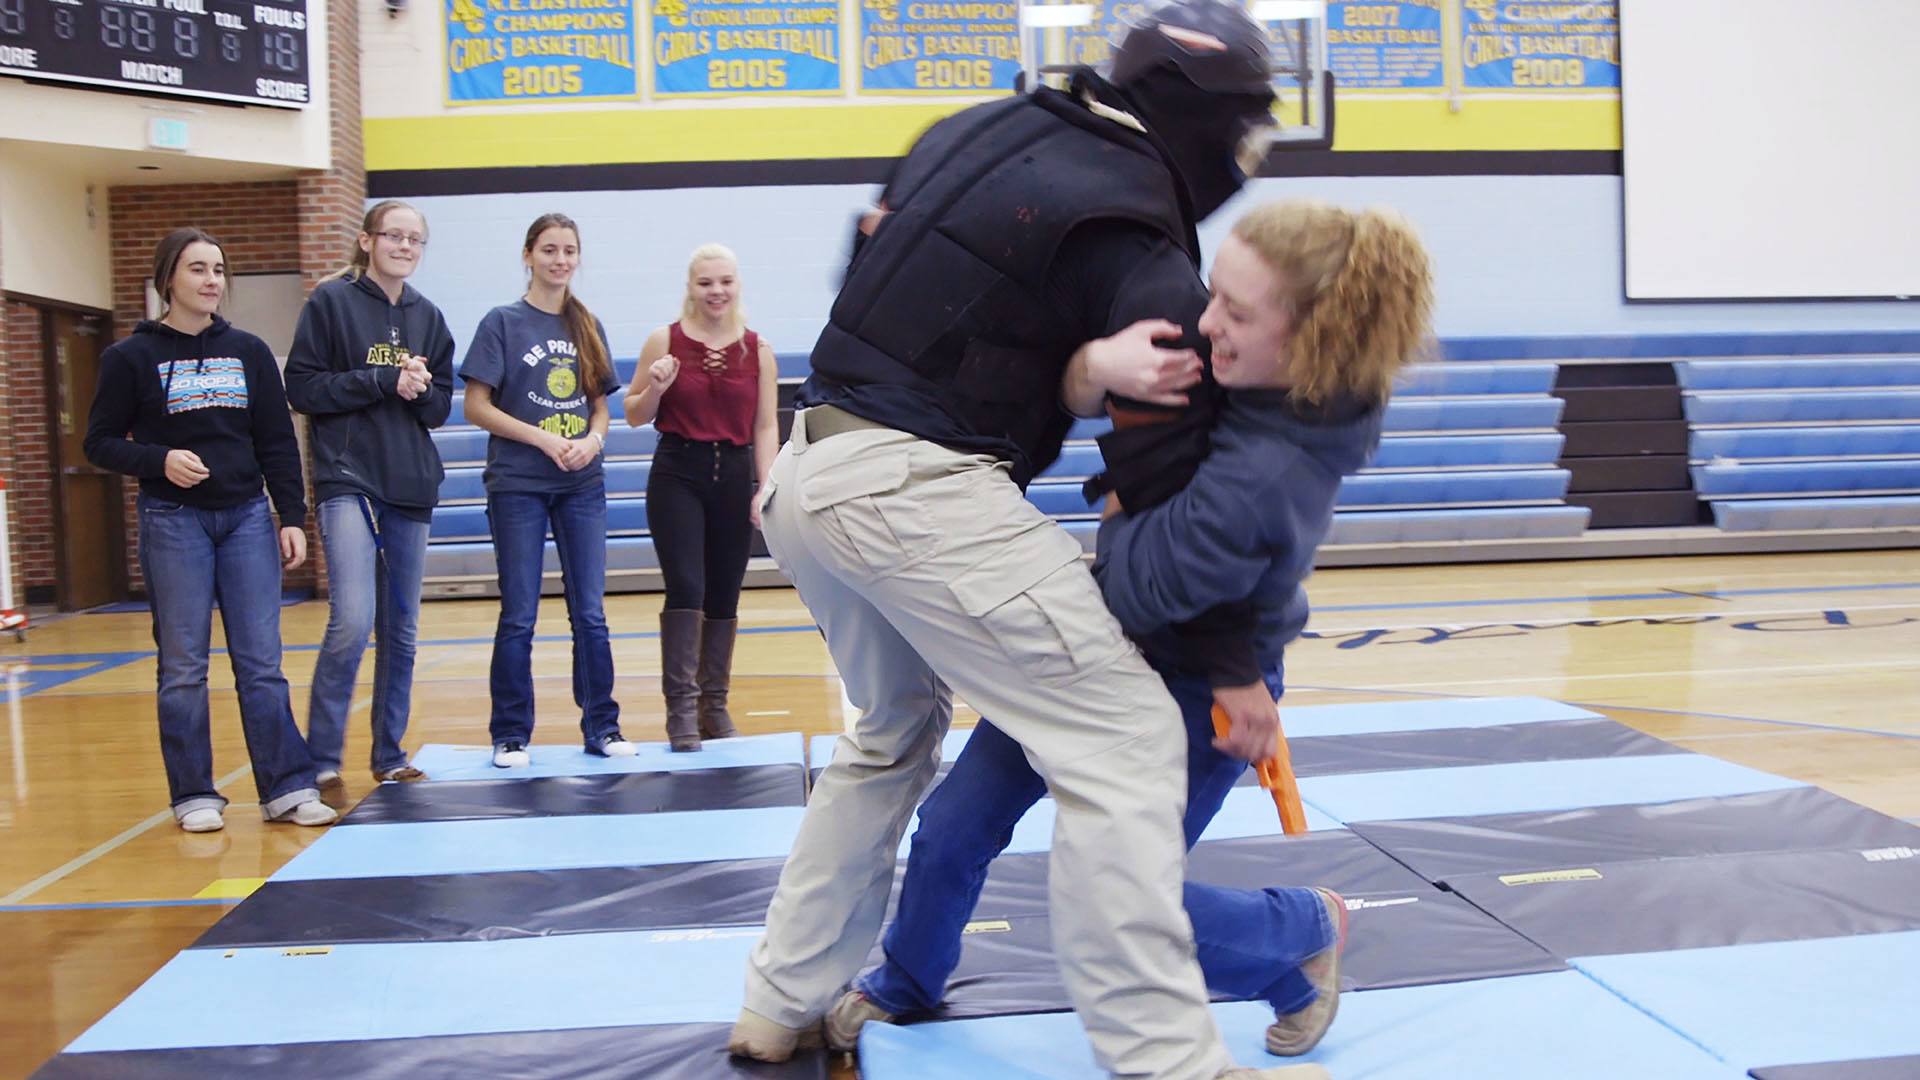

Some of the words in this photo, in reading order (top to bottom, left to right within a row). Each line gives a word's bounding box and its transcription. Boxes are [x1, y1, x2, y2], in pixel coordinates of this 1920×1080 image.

[254, 5, 306, 30] FOULS
[493, 12, 627, 33] CHAMPIONS
[655, 31, 711, 66] GIRLS
[716, 29, 838, 64] BASKETBALL
[1327, 28, 1441, 44] BASKETBALL
[450, 37, 506, 73] GIRLS
[511, 34, 633, 69] BASKETBALL
[863, 36, 918, 70] GIRLS
[1463, 35, 1516, 68] GIRLS
[121, 60, 183, 86] MATCH
[503, 65, 582, 96] 2005
[708, 59, 787, 88] 2005
[914, 59, 993, 88] 2006
[256, 77, 308, 102] SCORE
[522, 344, 547, 368] BE
